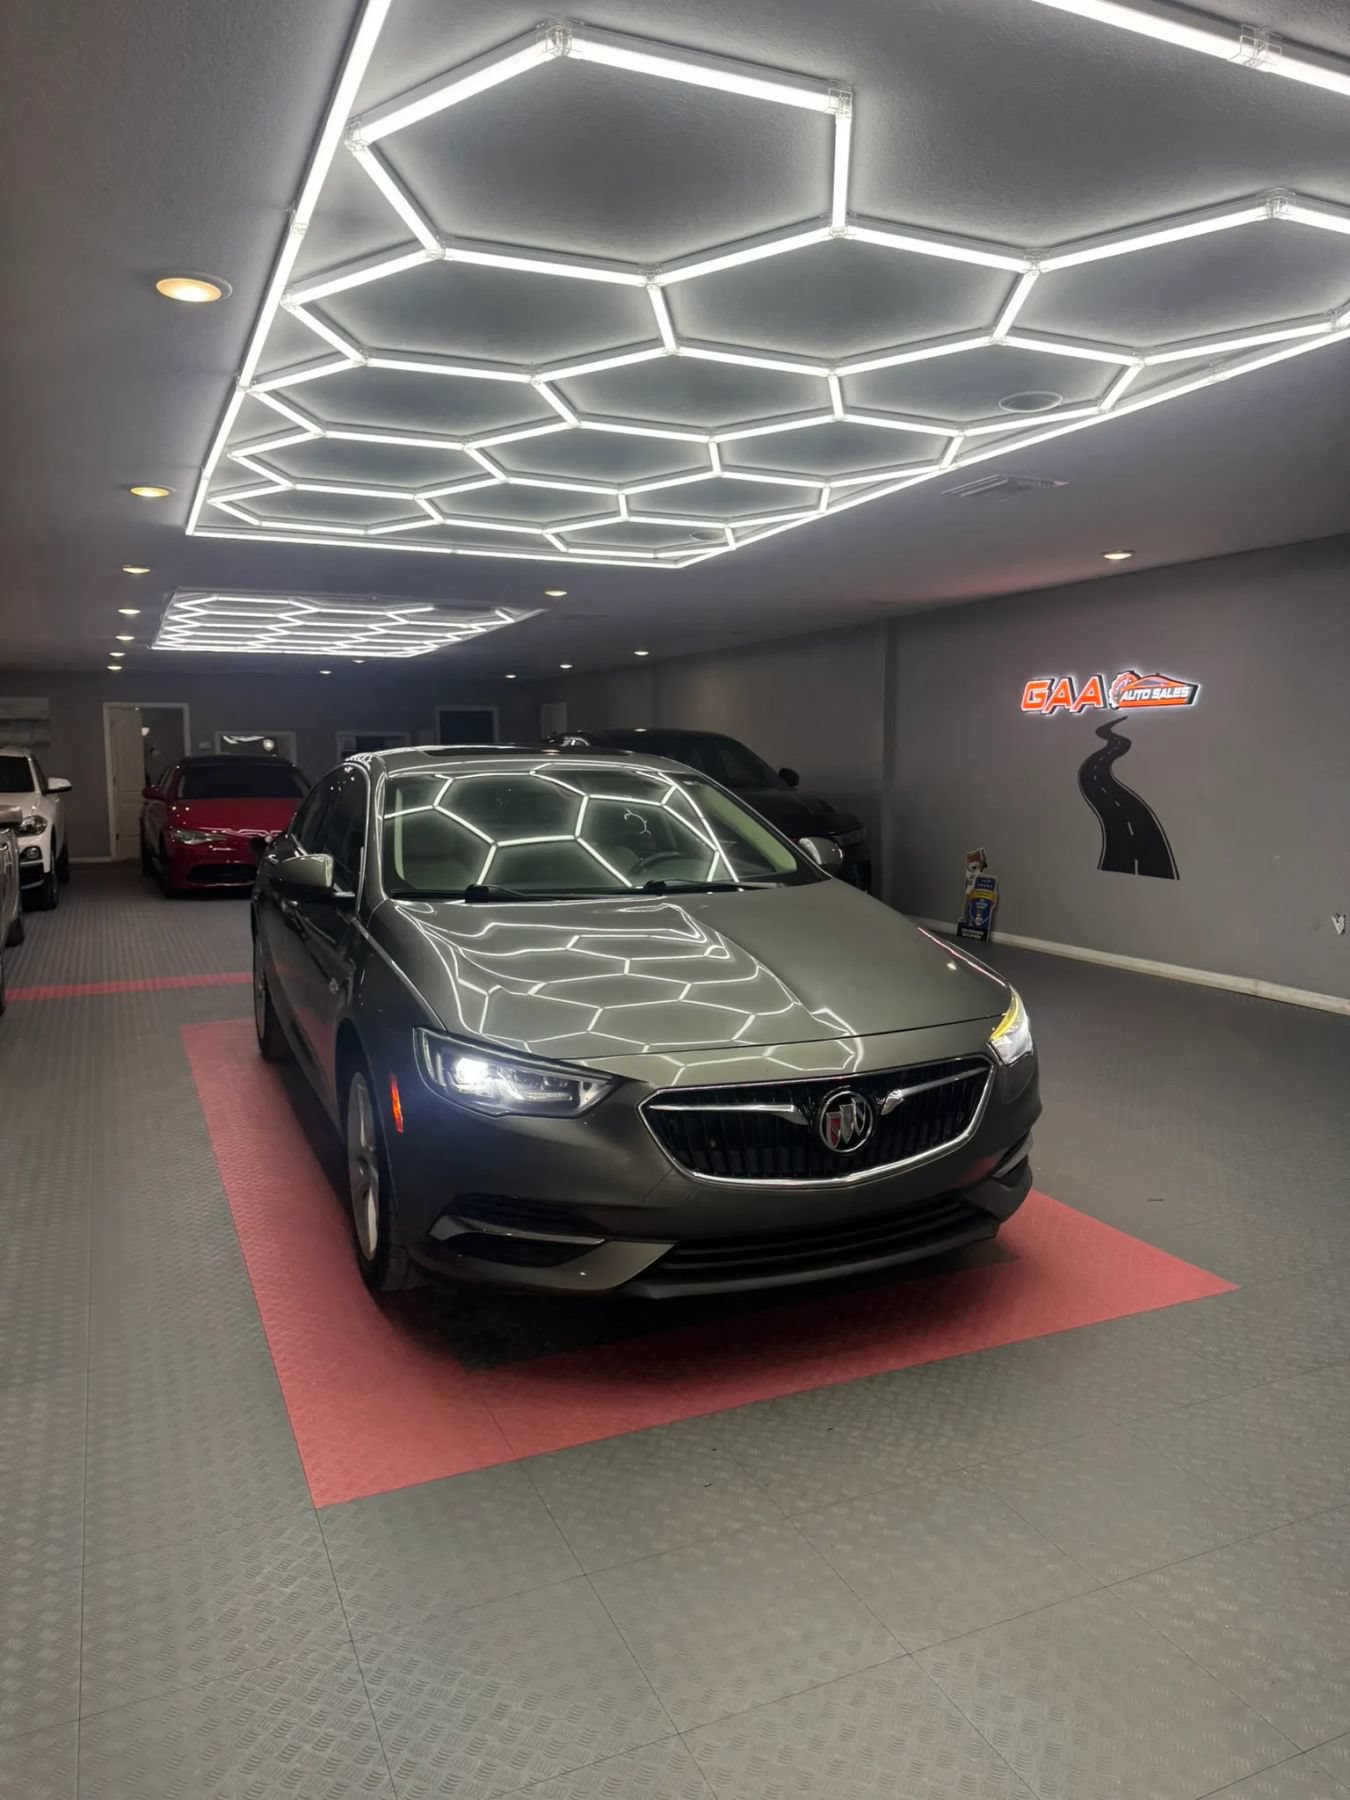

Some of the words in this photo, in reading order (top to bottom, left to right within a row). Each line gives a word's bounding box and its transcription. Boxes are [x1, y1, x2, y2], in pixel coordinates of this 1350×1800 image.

[1021, 675, 1105, 713] GAA
[1121, 688, 1151, 701] AUTO
[1152, 686, 1190, 699] SALES
